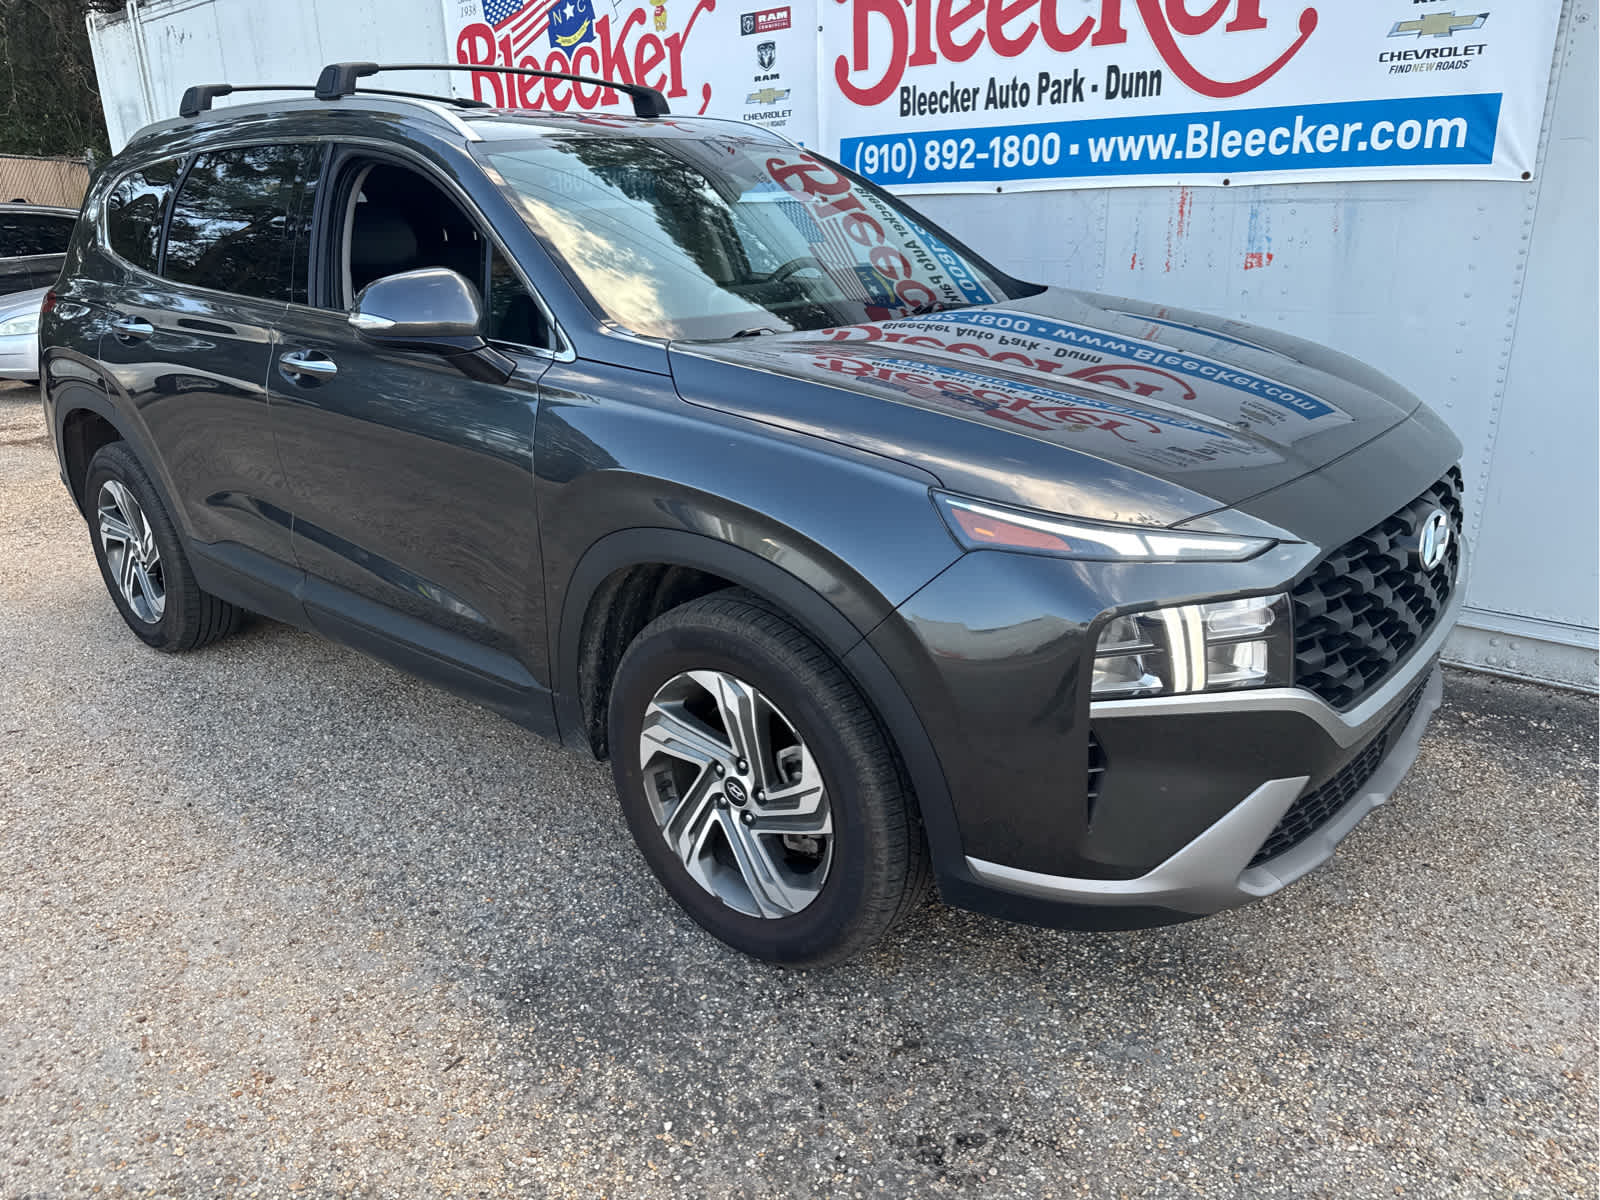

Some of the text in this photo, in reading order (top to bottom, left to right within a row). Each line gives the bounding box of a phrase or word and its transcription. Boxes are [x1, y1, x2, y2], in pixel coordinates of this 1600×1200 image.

[757, 10, 788, 23] RAM
[1379, 43, 1488, 63] CHEVROLET
[754, 73, 780, 82] RAM
[899, 81, 980, 118] Bleecker
[984, 76, 1030, 110] Auto
[1036, 69, 1085, 106] Park
[1105, 64, 1162, 100] Dunn
[743, 109, 792, 122] CHEVROLET
[854, 137, 917, 179] (910)
[924, 131, 1061, 171] 892-1800
[1087, 115, 1468, 163] www.Bleecker.com
